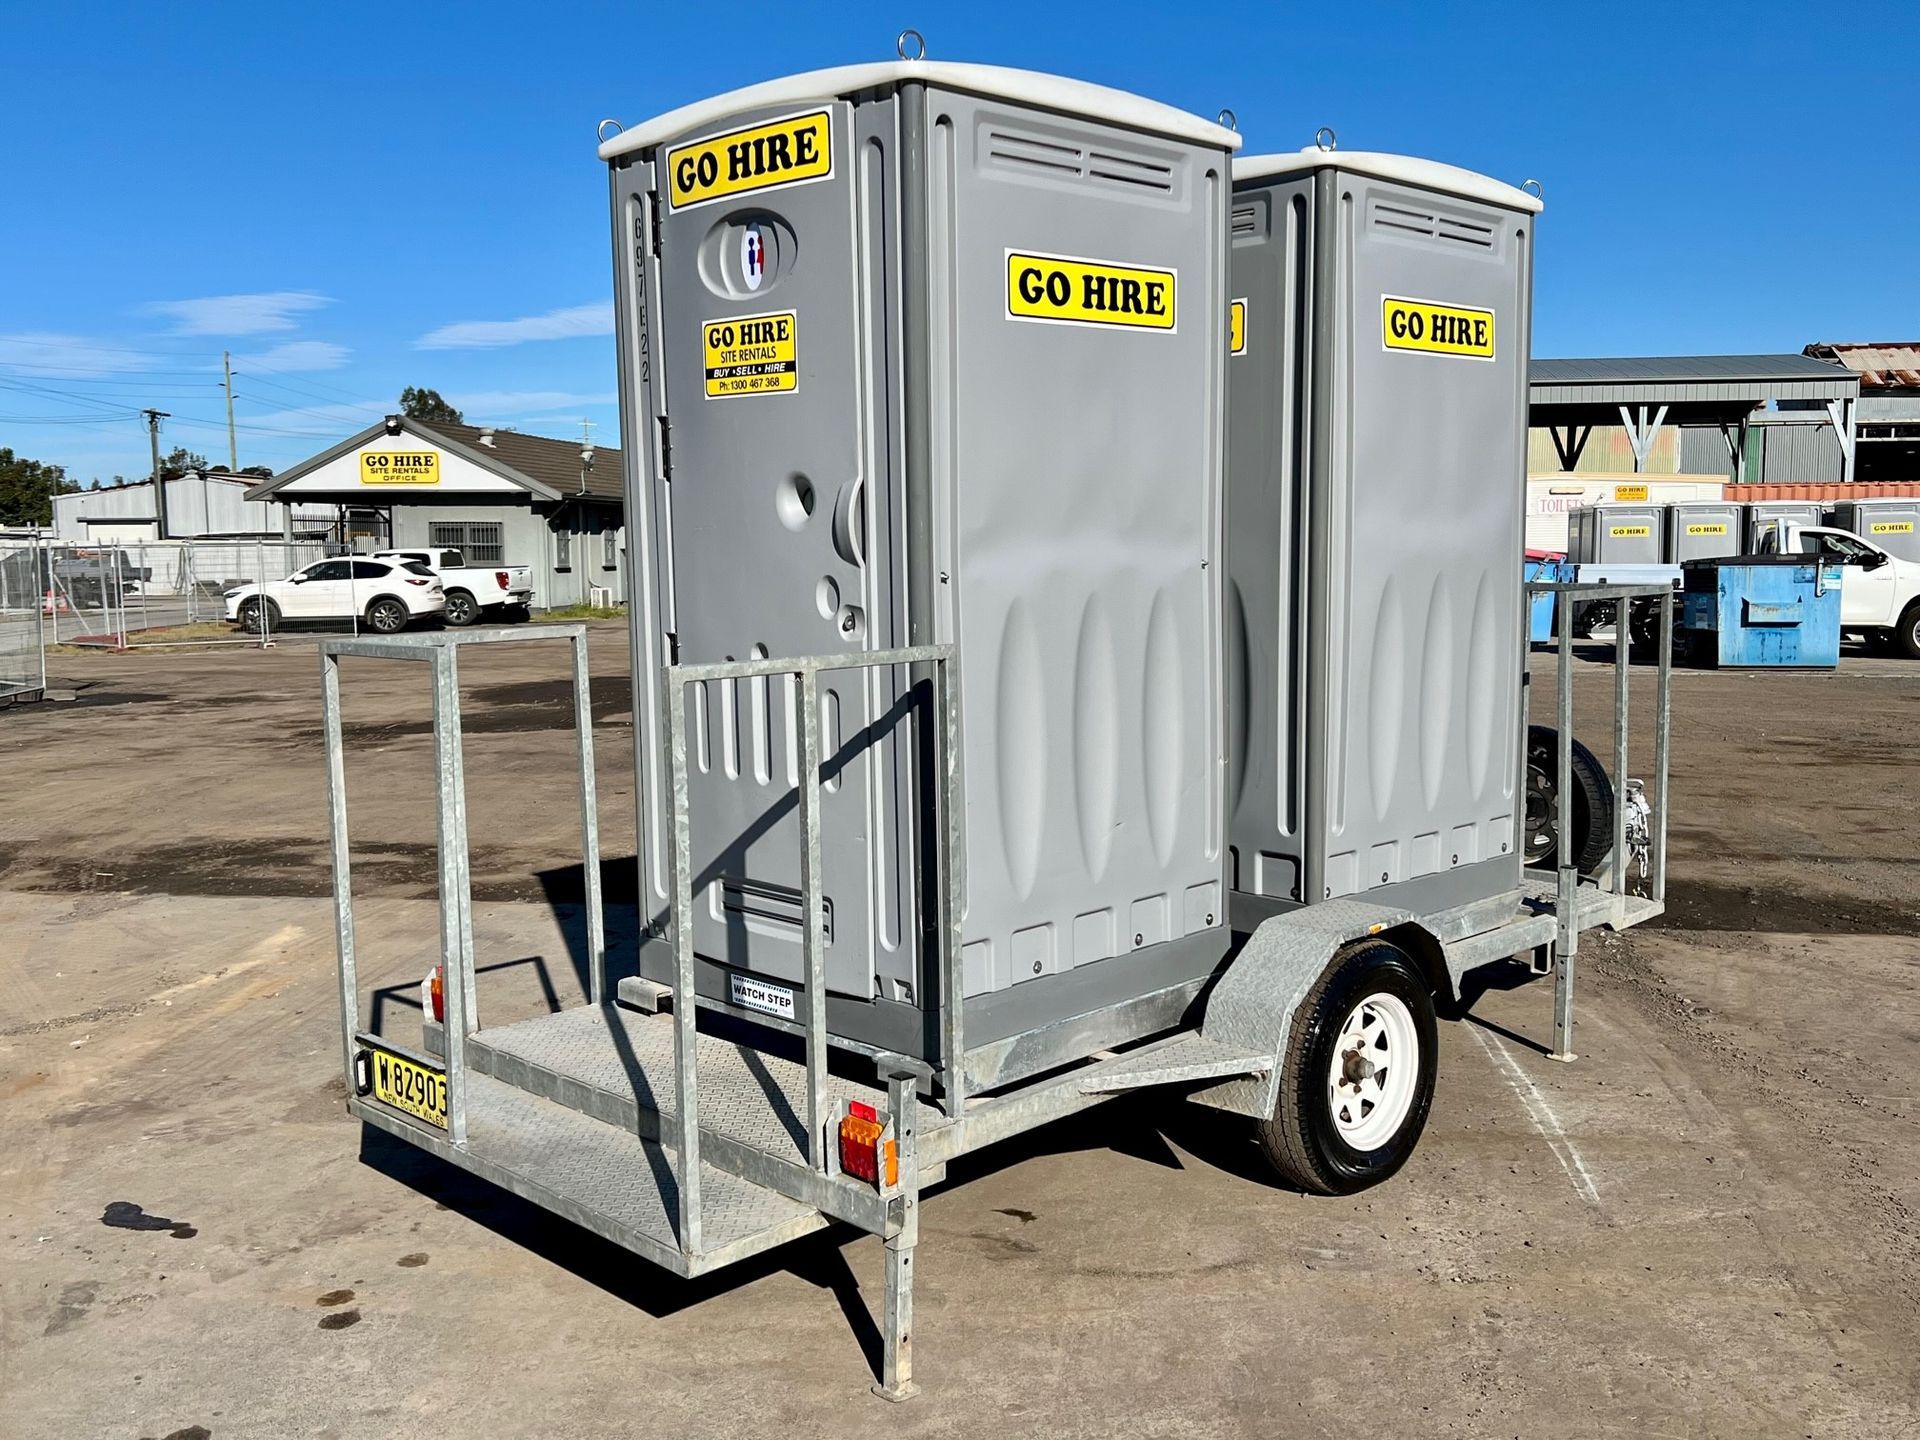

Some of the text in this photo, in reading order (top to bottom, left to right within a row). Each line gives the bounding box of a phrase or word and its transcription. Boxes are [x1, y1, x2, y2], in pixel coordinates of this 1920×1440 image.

[676, 125, 819, 193] GO HIRE
[1018, 267, 1166, 316] GO HIRE
[709, 319, 789, 349] GO HIRE
[1390, 308, 1488, 348] GO HIRE
[720, 346, 777, 363] SITE RENTALS
[713, 368, 730, 378] BUY
[764, 362, 786, 373] HIRE
[749, 378, 763, 389] 467
[765, 376, 780, 387] 368
[366, 456, 434, 467] GO HIRE
[733, 984, 792, 1008] WATCH STEP
[383, 1092, 444, 1127] NEW SOUTH WALES
